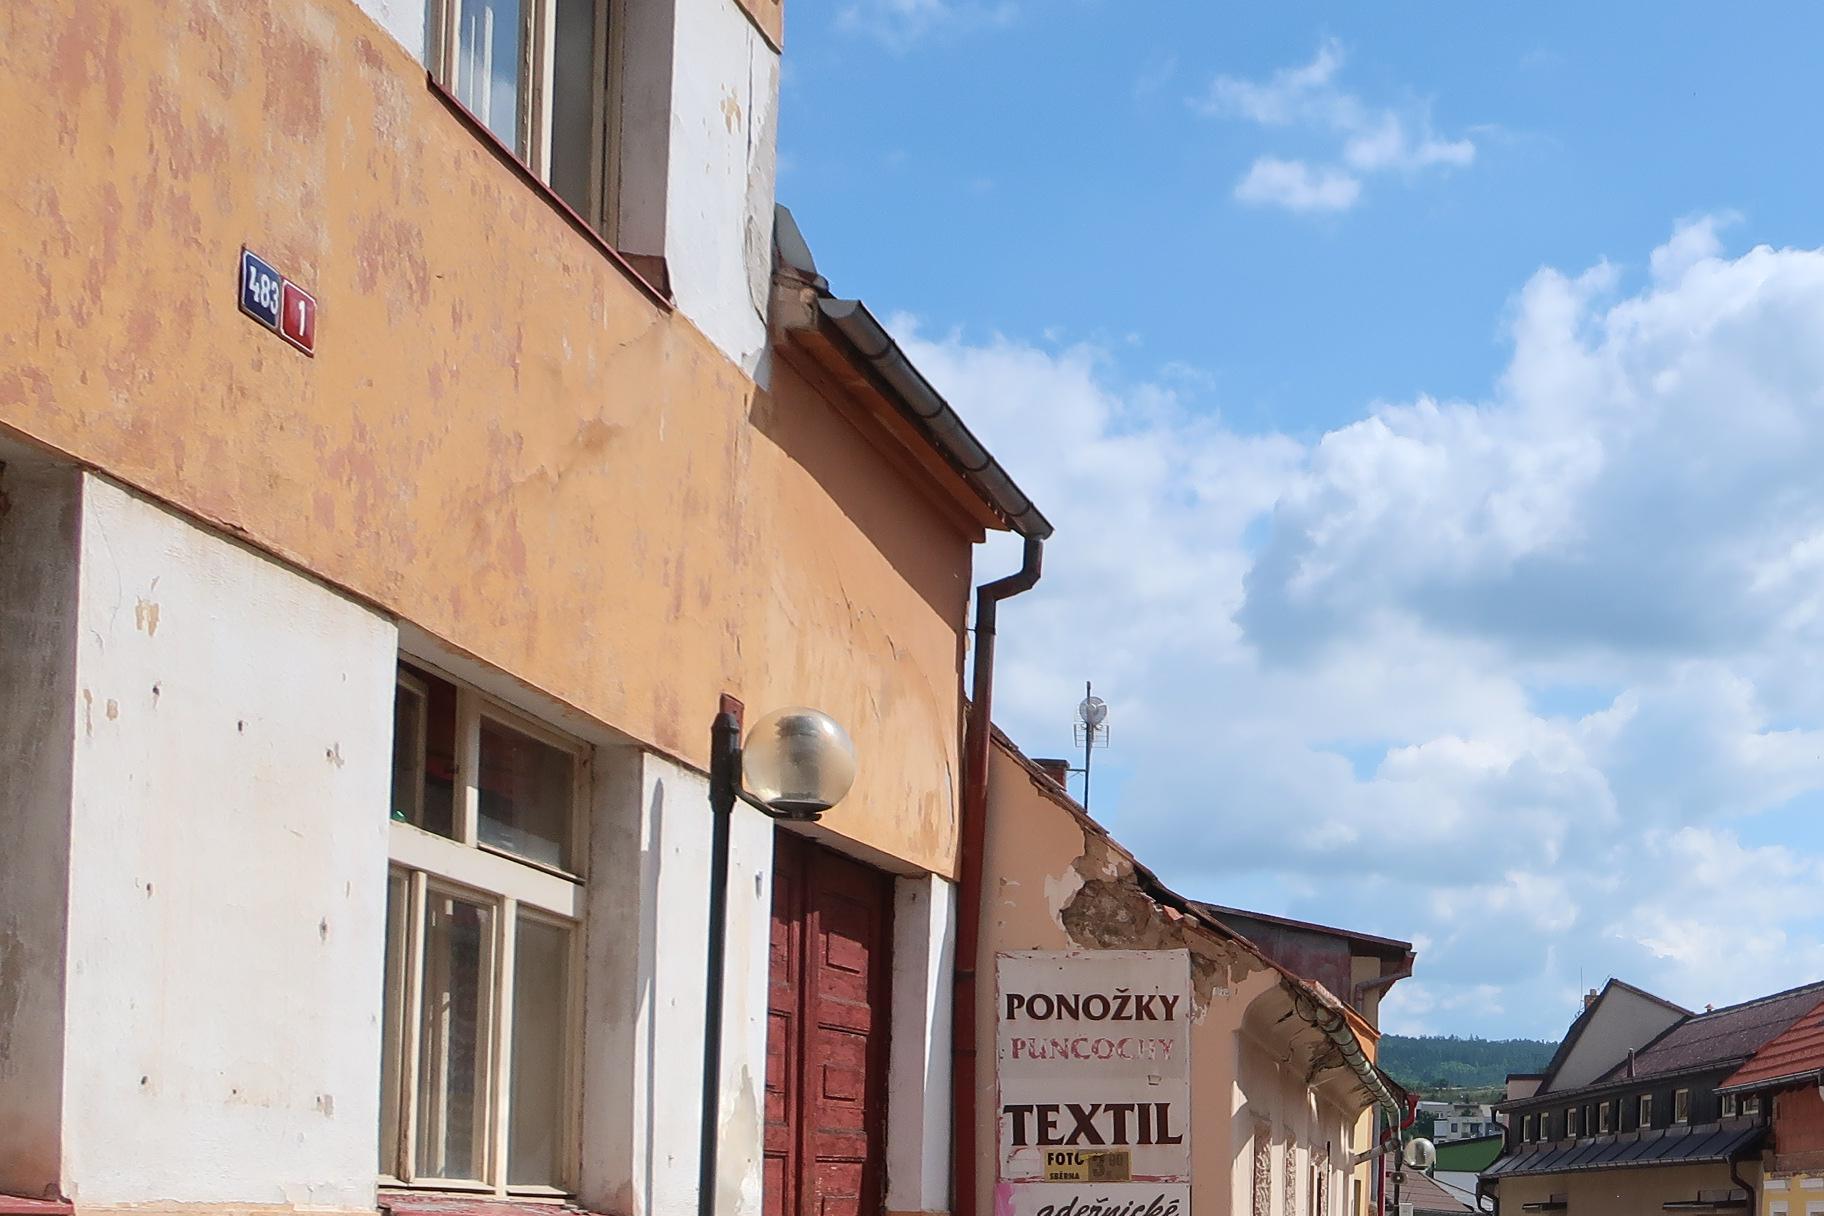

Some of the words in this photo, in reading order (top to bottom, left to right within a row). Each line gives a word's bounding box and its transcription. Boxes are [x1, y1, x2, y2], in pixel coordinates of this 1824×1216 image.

[248, 265, 279, 315] 483
[298, 300, 306, 337] 1
[1006, 987, 1180, 1021] PONOŽKY
[1003, 1102, 1183, 1146] TEXTIL
[1049, 1170, 1080, 1180] SBĚRNA
